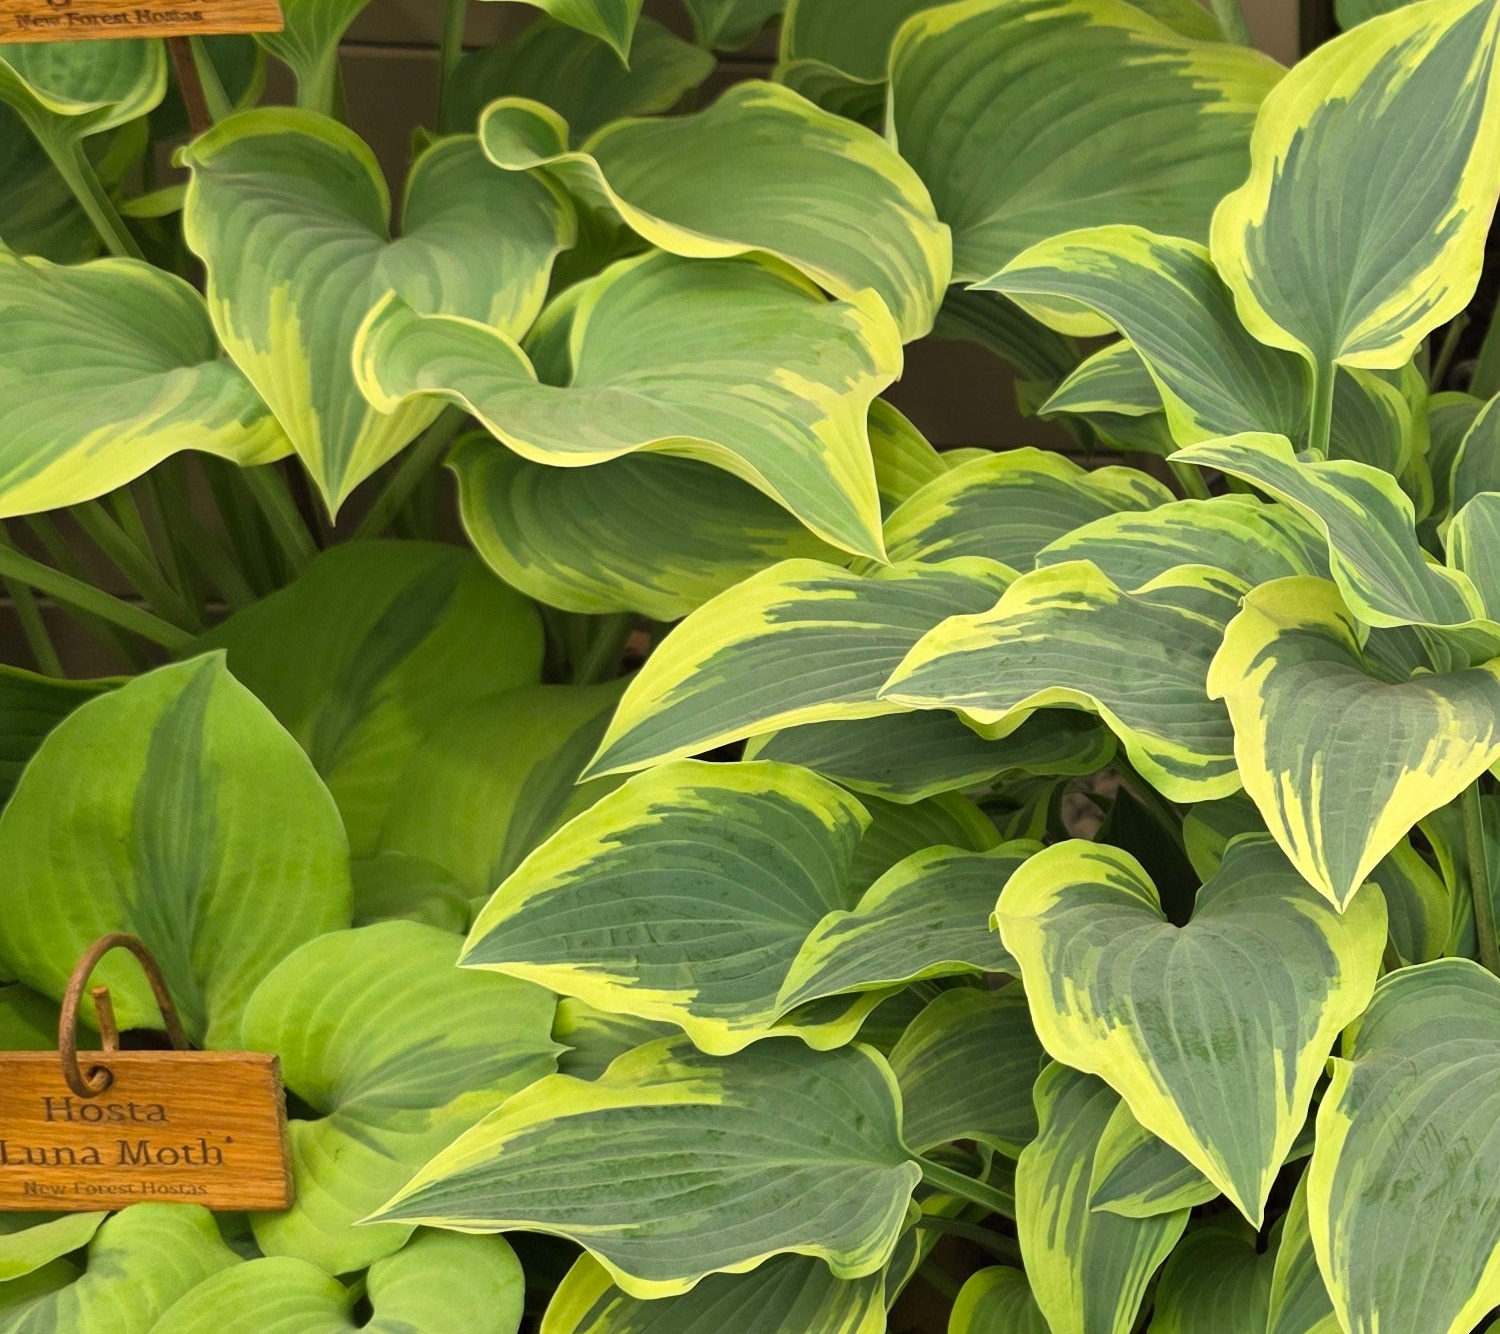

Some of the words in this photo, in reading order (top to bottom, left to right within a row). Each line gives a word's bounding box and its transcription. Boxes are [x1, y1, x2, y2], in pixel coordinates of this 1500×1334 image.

[15, 13, 61, 29] New
[65, 12, 130, 28] Forest
[135, 10, 203, 26] Hostas
[41, 1095, 169, 1124] Hosta
[116, 1135, 235, 1167] Moth'
[23, 1181, 66, 1195] New
[72, 1181, 135, 1196] Forest
[141, 1180, 209, 1195] Hostas
